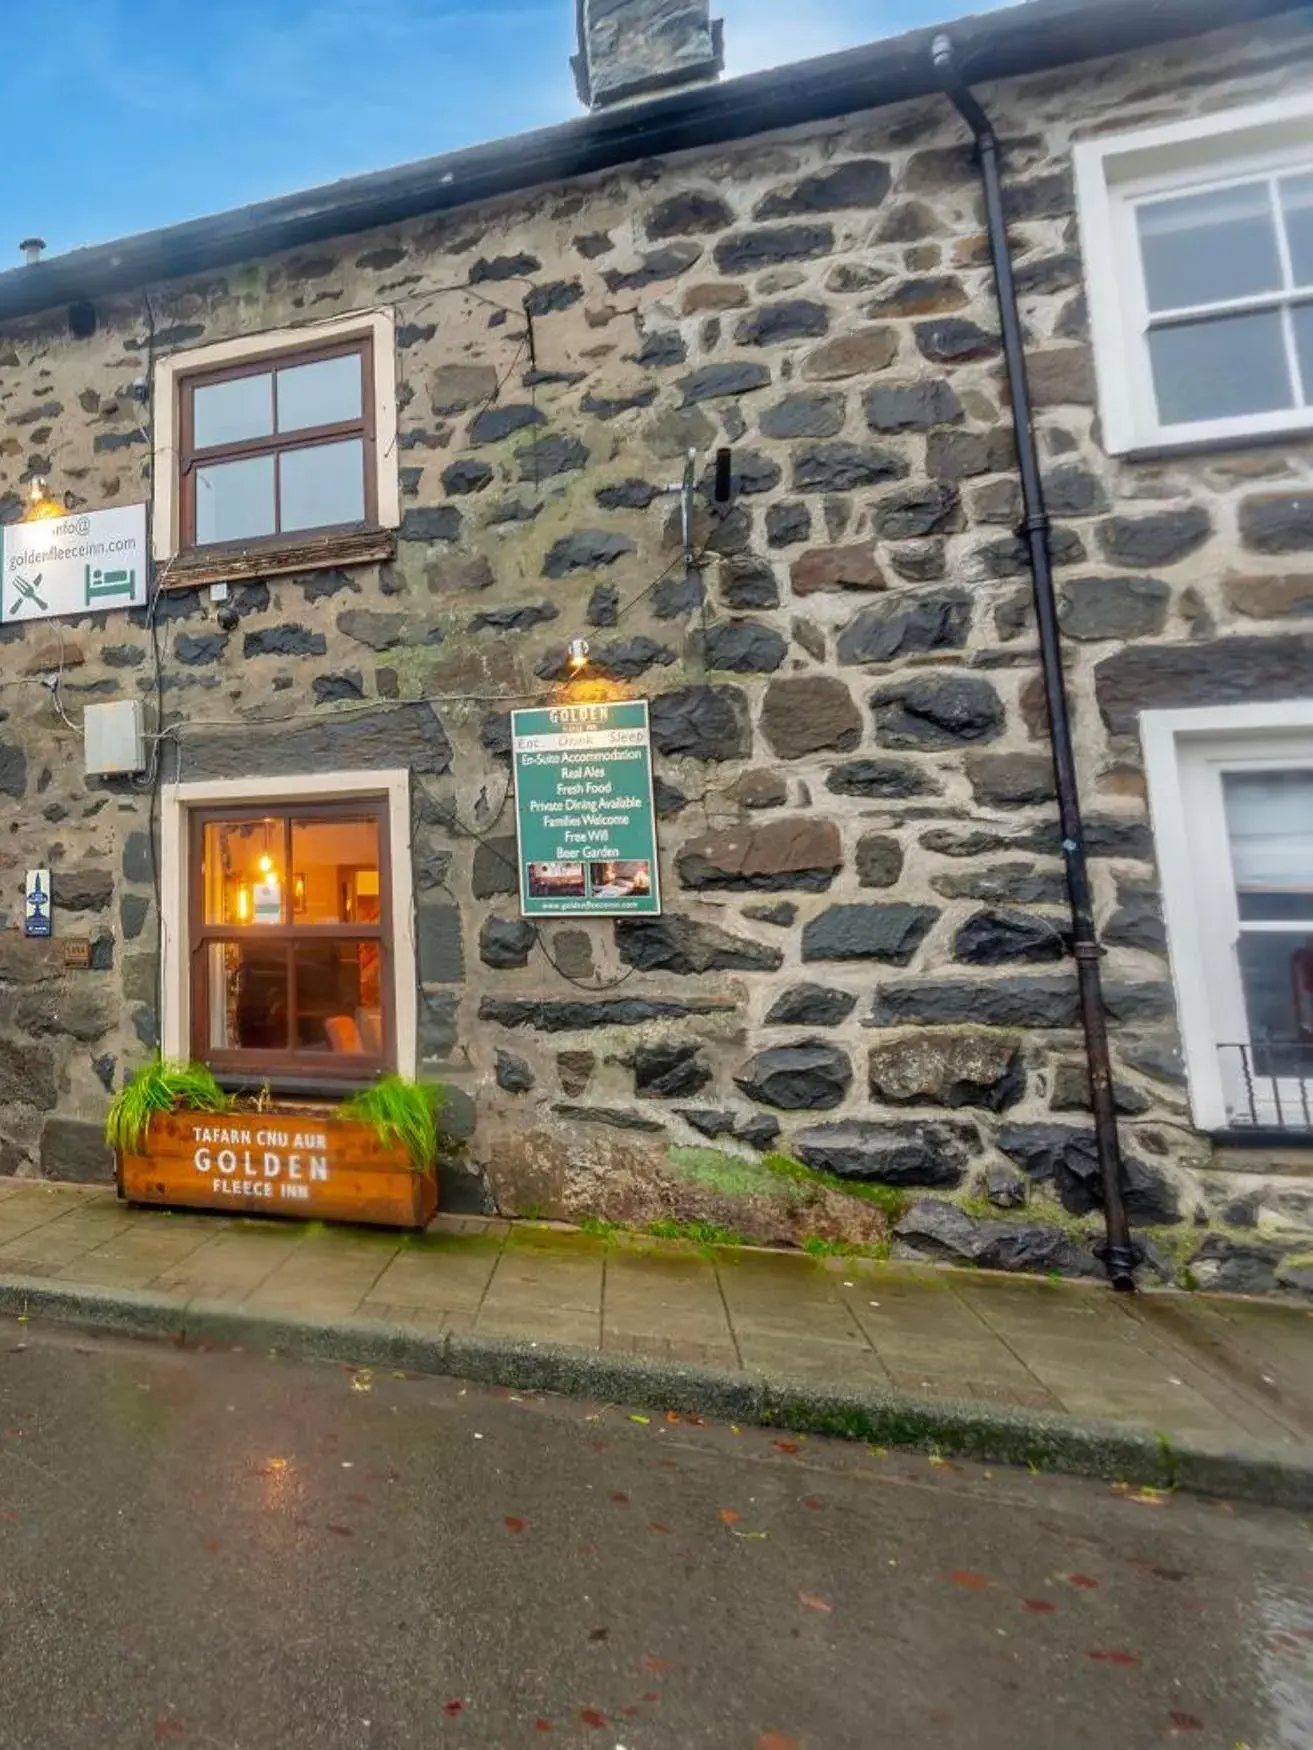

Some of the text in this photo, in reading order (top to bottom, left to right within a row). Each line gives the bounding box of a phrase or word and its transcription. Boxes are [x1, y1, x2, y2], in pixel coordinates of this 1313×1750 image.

[8, 537, 136, 572] goldenfleeceinn.com
[549, 706, 609, 724] GOLDEN
[561, 749, 642, 763] Accommodation
[561, 766, 606, 780] Real Ales
[556, 781, 612, 796] Fresh Food
[529, 797, 642, 812] Private Dining Available
[543, 813, 630, 828] Families Welcome
[564, 830, 588, 843] Free
[556, 846, 620, 859] Beer Garden
[192, 1126, 327, 1150] TAFARN CNU AUR
[194, 1147, 329, 1182] GOLDEN
[212, 1177, 310, 1200] FLEECE INN
